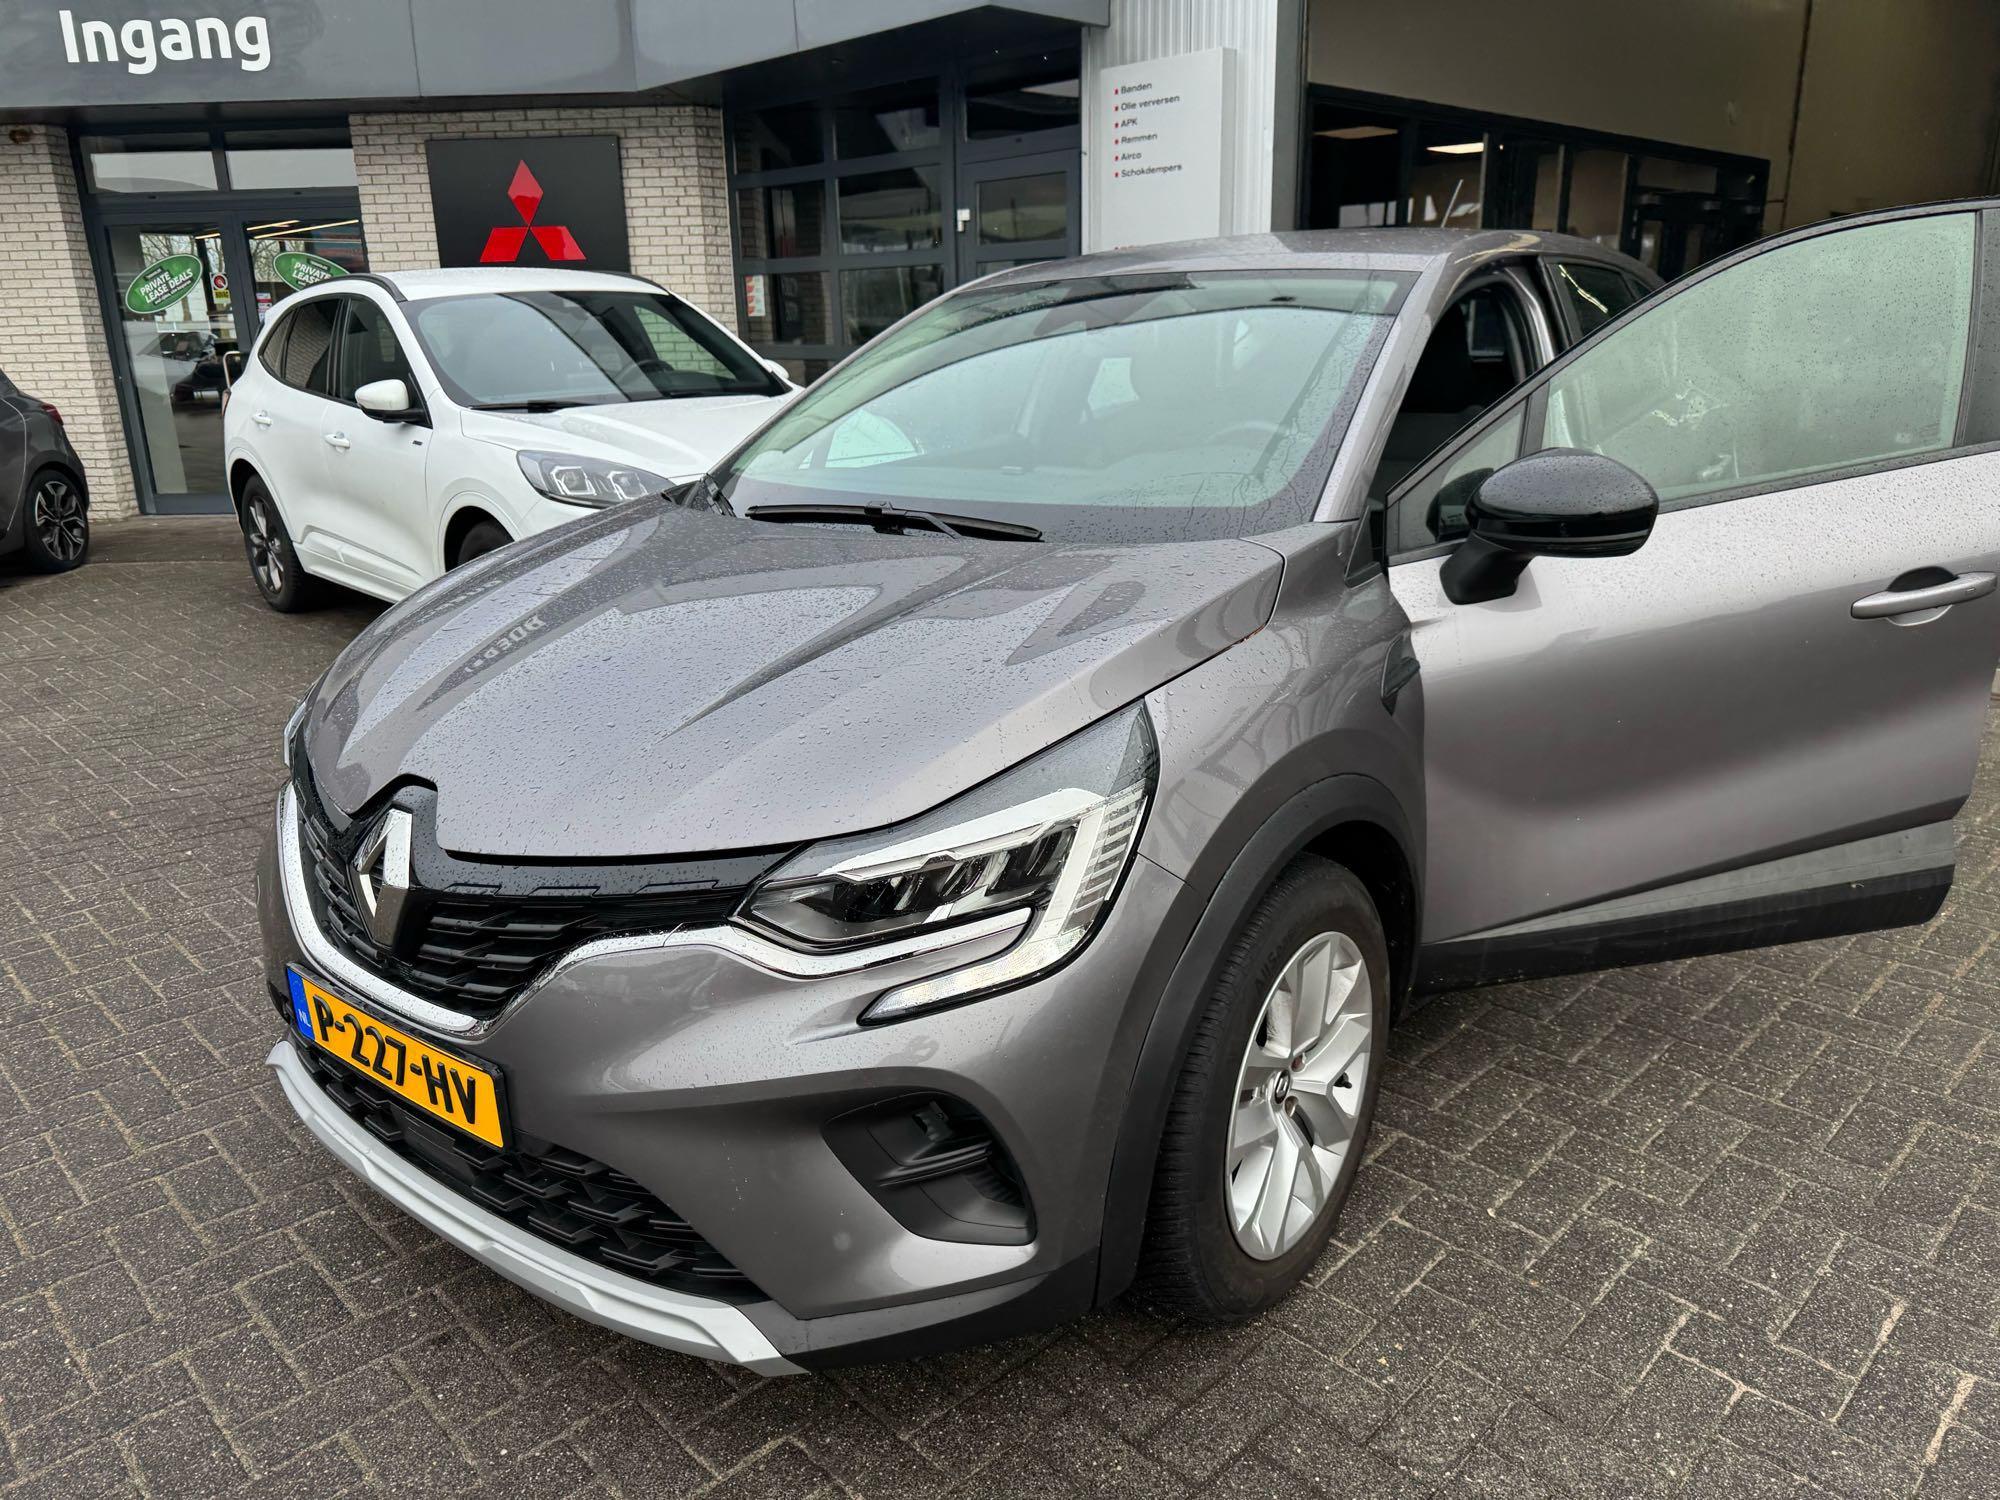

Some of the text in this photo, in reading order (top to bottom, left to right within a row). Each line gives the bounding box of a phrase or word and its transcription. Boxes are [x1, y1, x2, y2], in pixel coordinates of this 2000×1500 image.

[59, 9, 271, 75] Ingang
[1121, 83, 1152, 94] Banden
[1121, 95, 1180, 111] Olie verversen
[1121, 118, 1138, 127] APK
[1121, 133, 1157, 144] Remmen
[1121, 152, 1142, 161] Airco
[1121, 164, 1182, 177] Schokdempers
[140, 271, 171, 296] PRIVATE
[145, 283, 169, 304] LEASE
[168, 268, 193, 289] DEALS
[298, 1008, 311, 1028] NL
[312, 995, 476, 1125] P-227-HV
